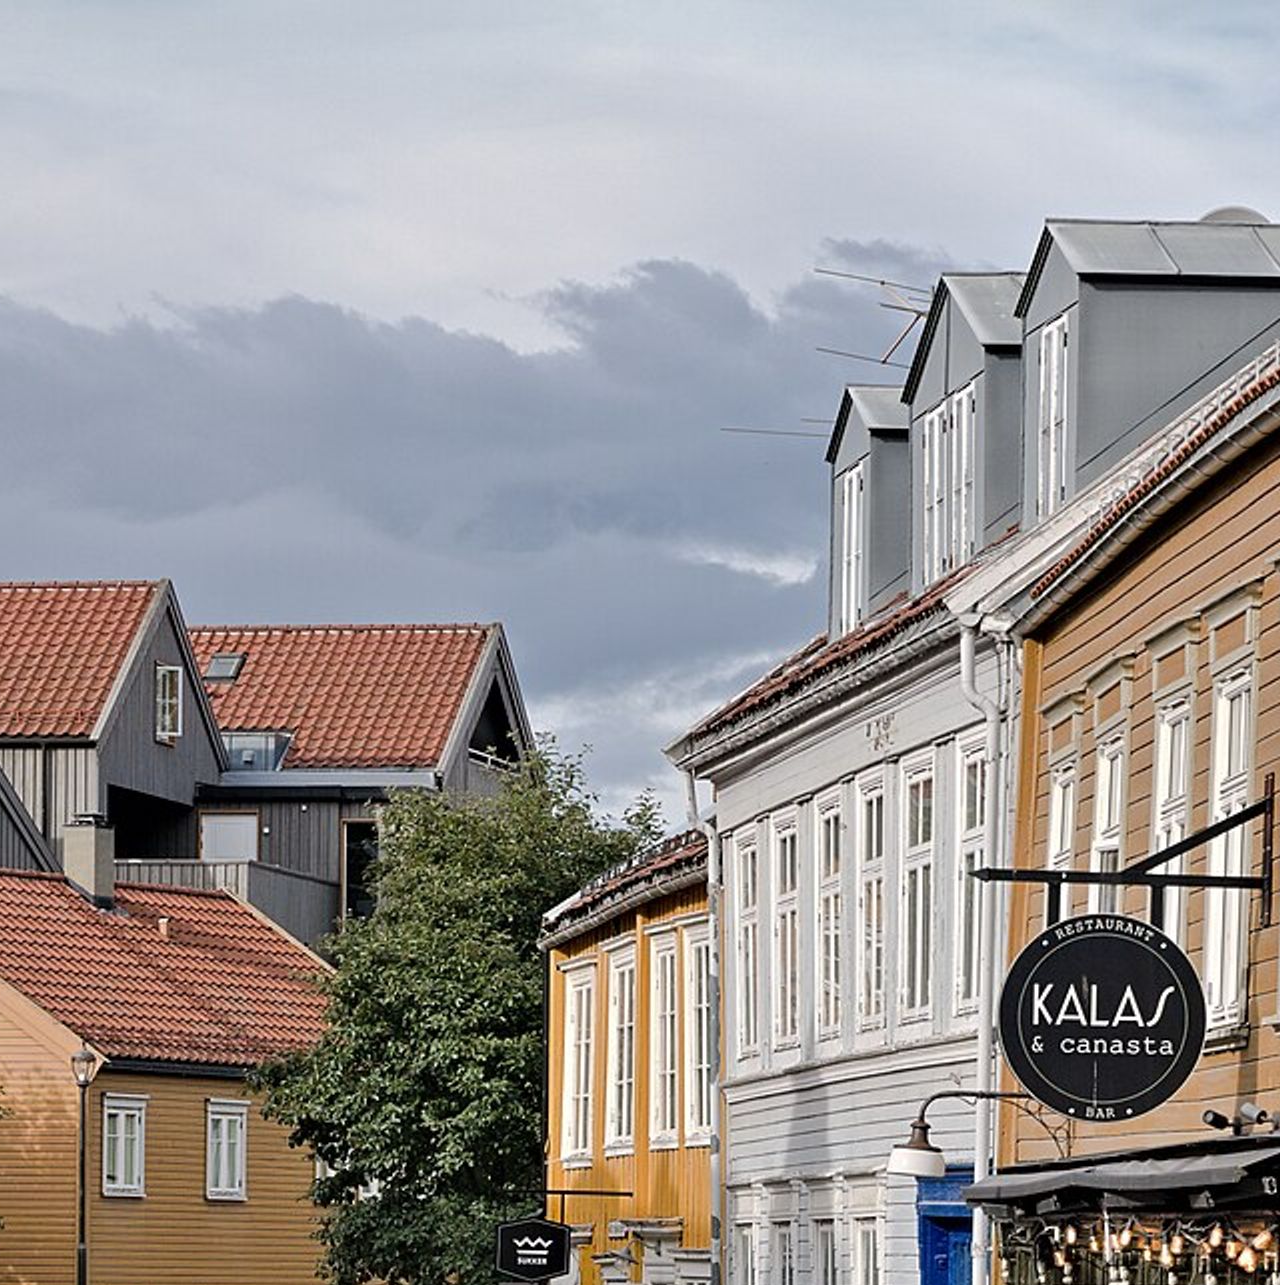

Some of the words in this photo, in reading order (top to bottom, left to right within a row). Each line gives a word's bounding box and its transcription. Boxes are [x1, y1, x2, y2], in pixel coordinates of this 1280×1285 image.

[1054, 918, 1155, 942] RESTAURANT
[1032, 983, 1175, 1028] KALAS
[1031, 1036, 1044, 1054] &
[1059, 1036, 1174, 1056] canasta
[1085, 1107, 1116, 1119] BAR
